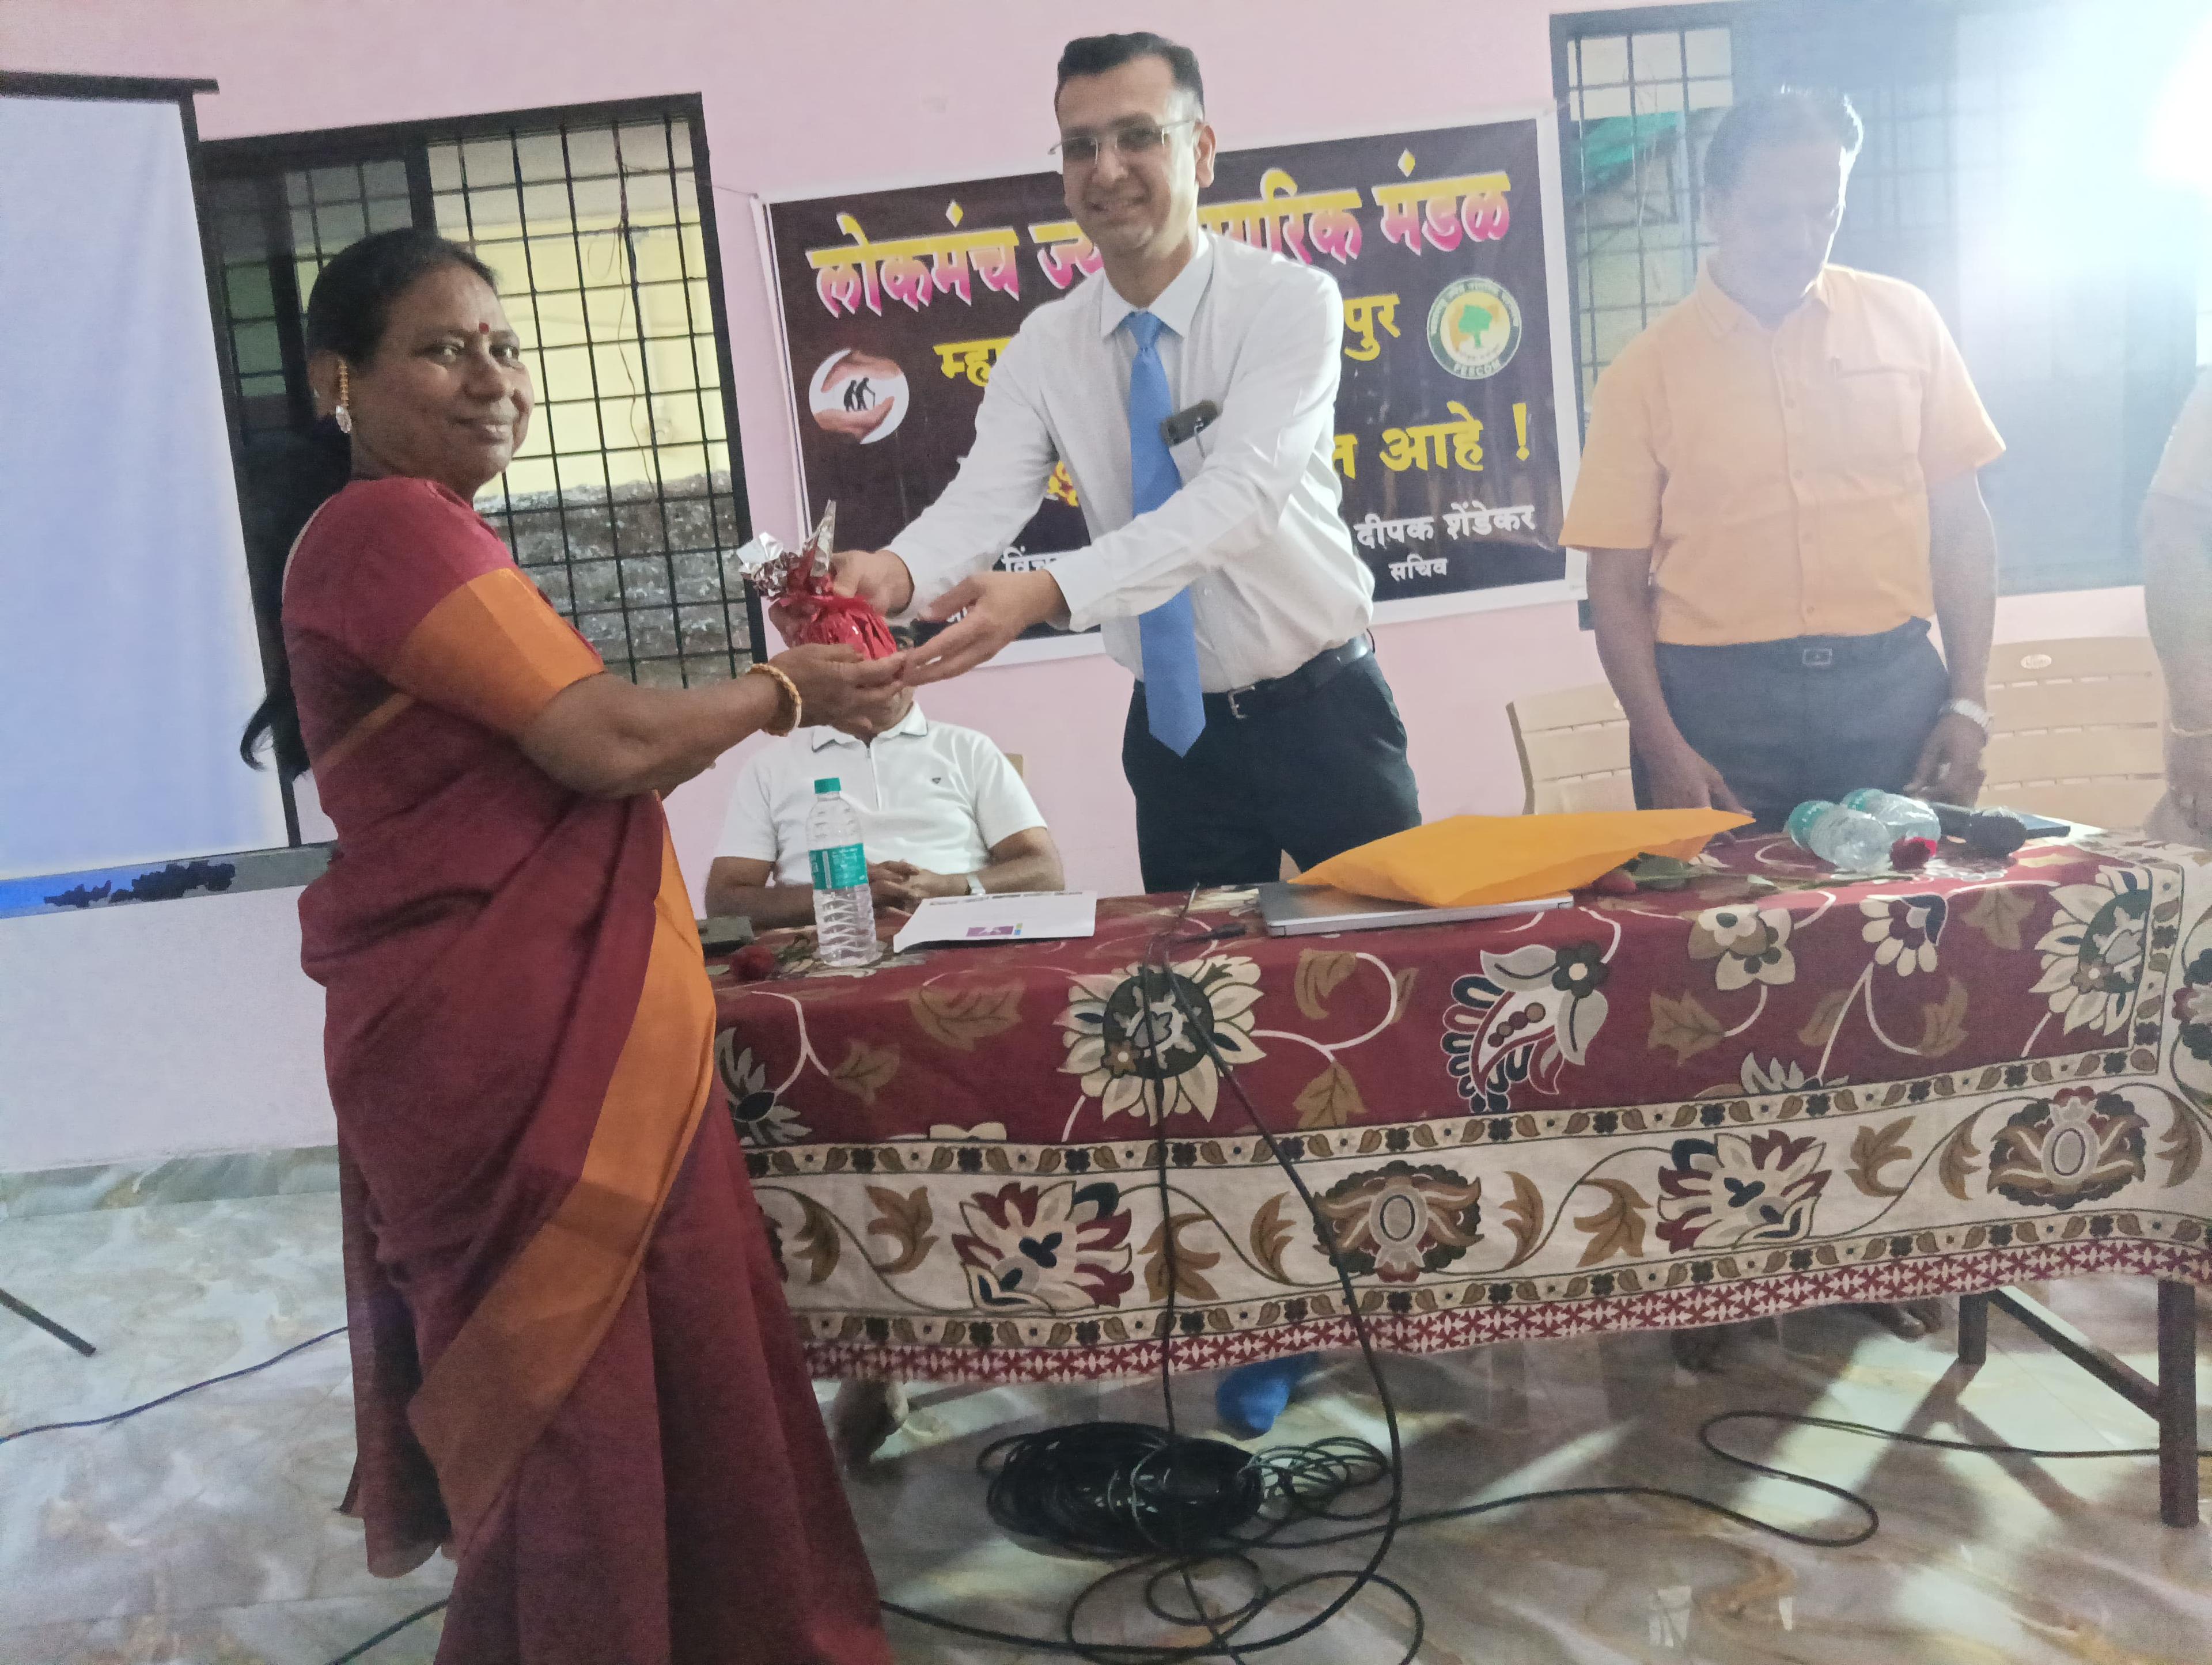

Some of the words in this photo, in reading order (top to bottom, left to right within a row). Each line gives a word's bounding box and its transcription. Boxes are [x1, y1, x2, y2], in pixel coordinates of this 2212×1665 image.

[805, 199, 1020, 318] लोकमंच
[1371, 148, 1511, 256] मंडळ
[1379, 400, 1484, 471] आहे
[1354, 513, 1434, 549] दीपक
[1442, 500, 1535, 540] शेंडेकर
[1388, 553, 1448, 582] सचिव
